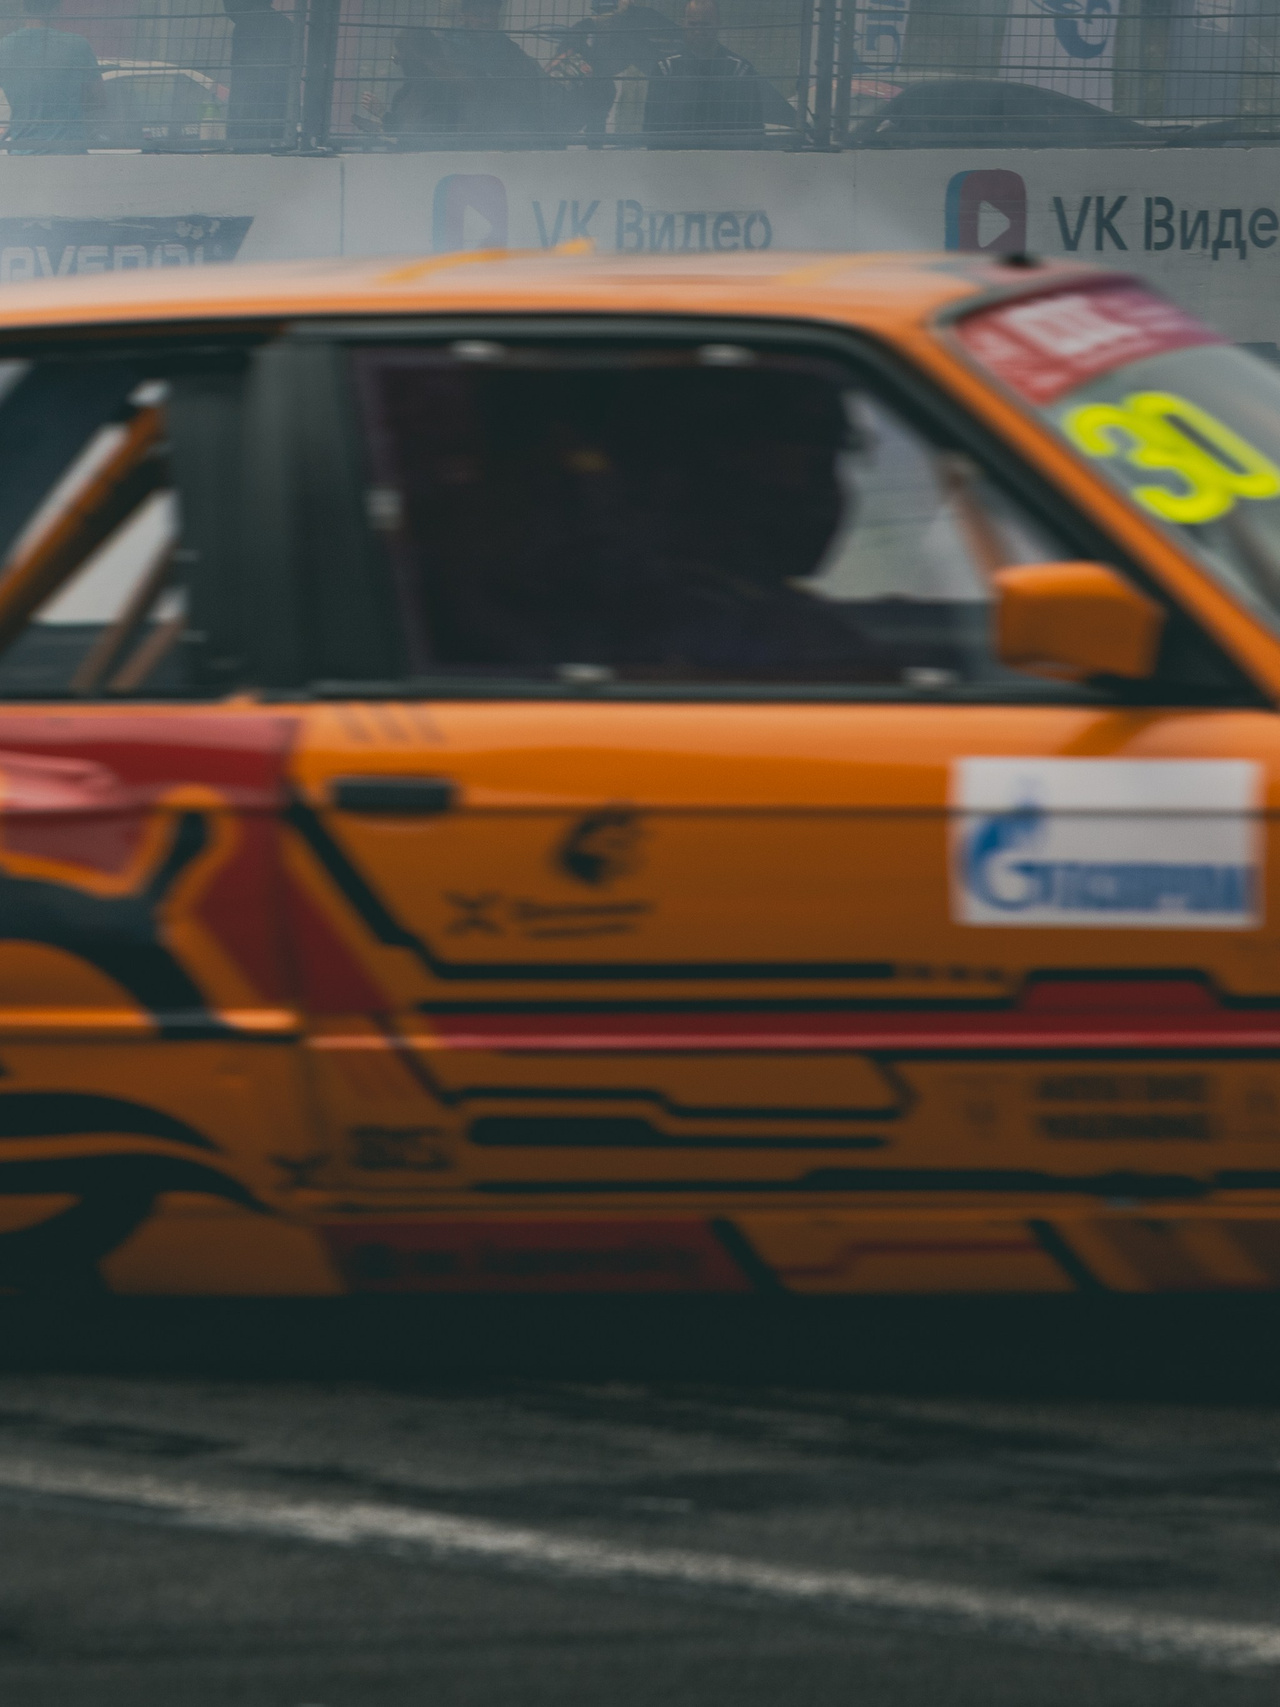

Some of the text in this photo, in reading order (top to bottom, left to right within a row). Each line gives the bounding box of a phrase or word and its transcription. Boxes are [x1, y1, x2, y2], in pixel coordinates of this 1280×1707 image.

[531, 199, 601, 250] VK
[1052, 195, 1128, 251] VK
[1063, 391, 1280, 523] 30
